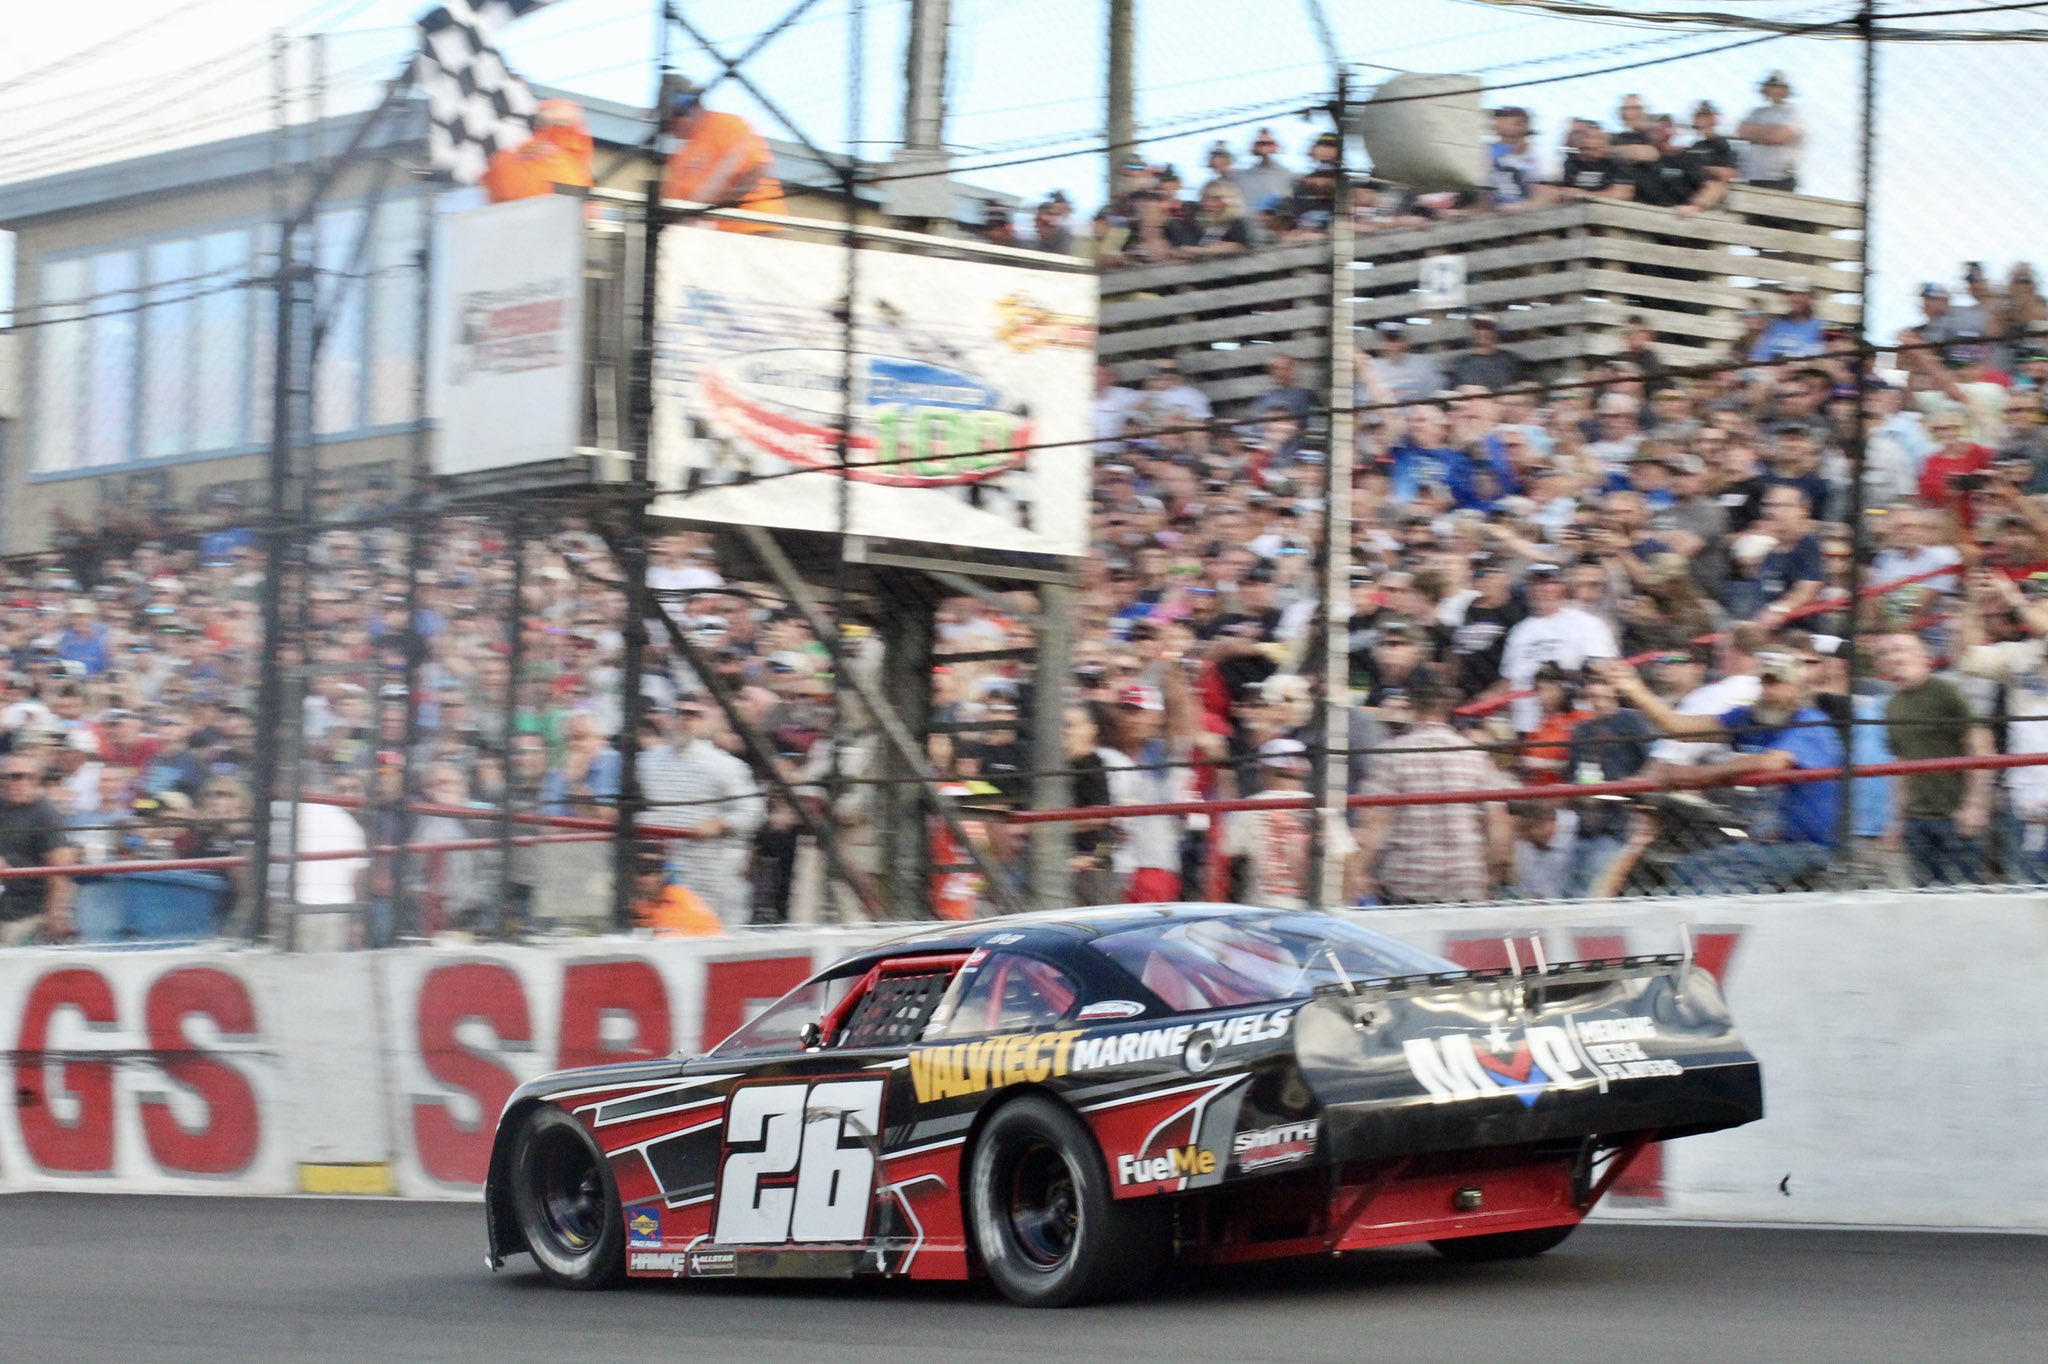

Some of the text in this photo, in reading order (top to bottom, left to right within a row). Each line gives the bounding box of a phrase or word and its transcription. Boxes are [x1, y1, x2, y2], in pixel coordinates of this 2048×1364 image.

[0, 964, 262, 1176] GS
[908, 1029, 1088, 1104] VALVTECT
[1071, 1023, 1193, 1072] MARINE
[1197, 1008, 1294, 1050] UELS
[714, 1080, 884, 1244] 26
[1117, 1146, 1216, 1185] FuelMe
